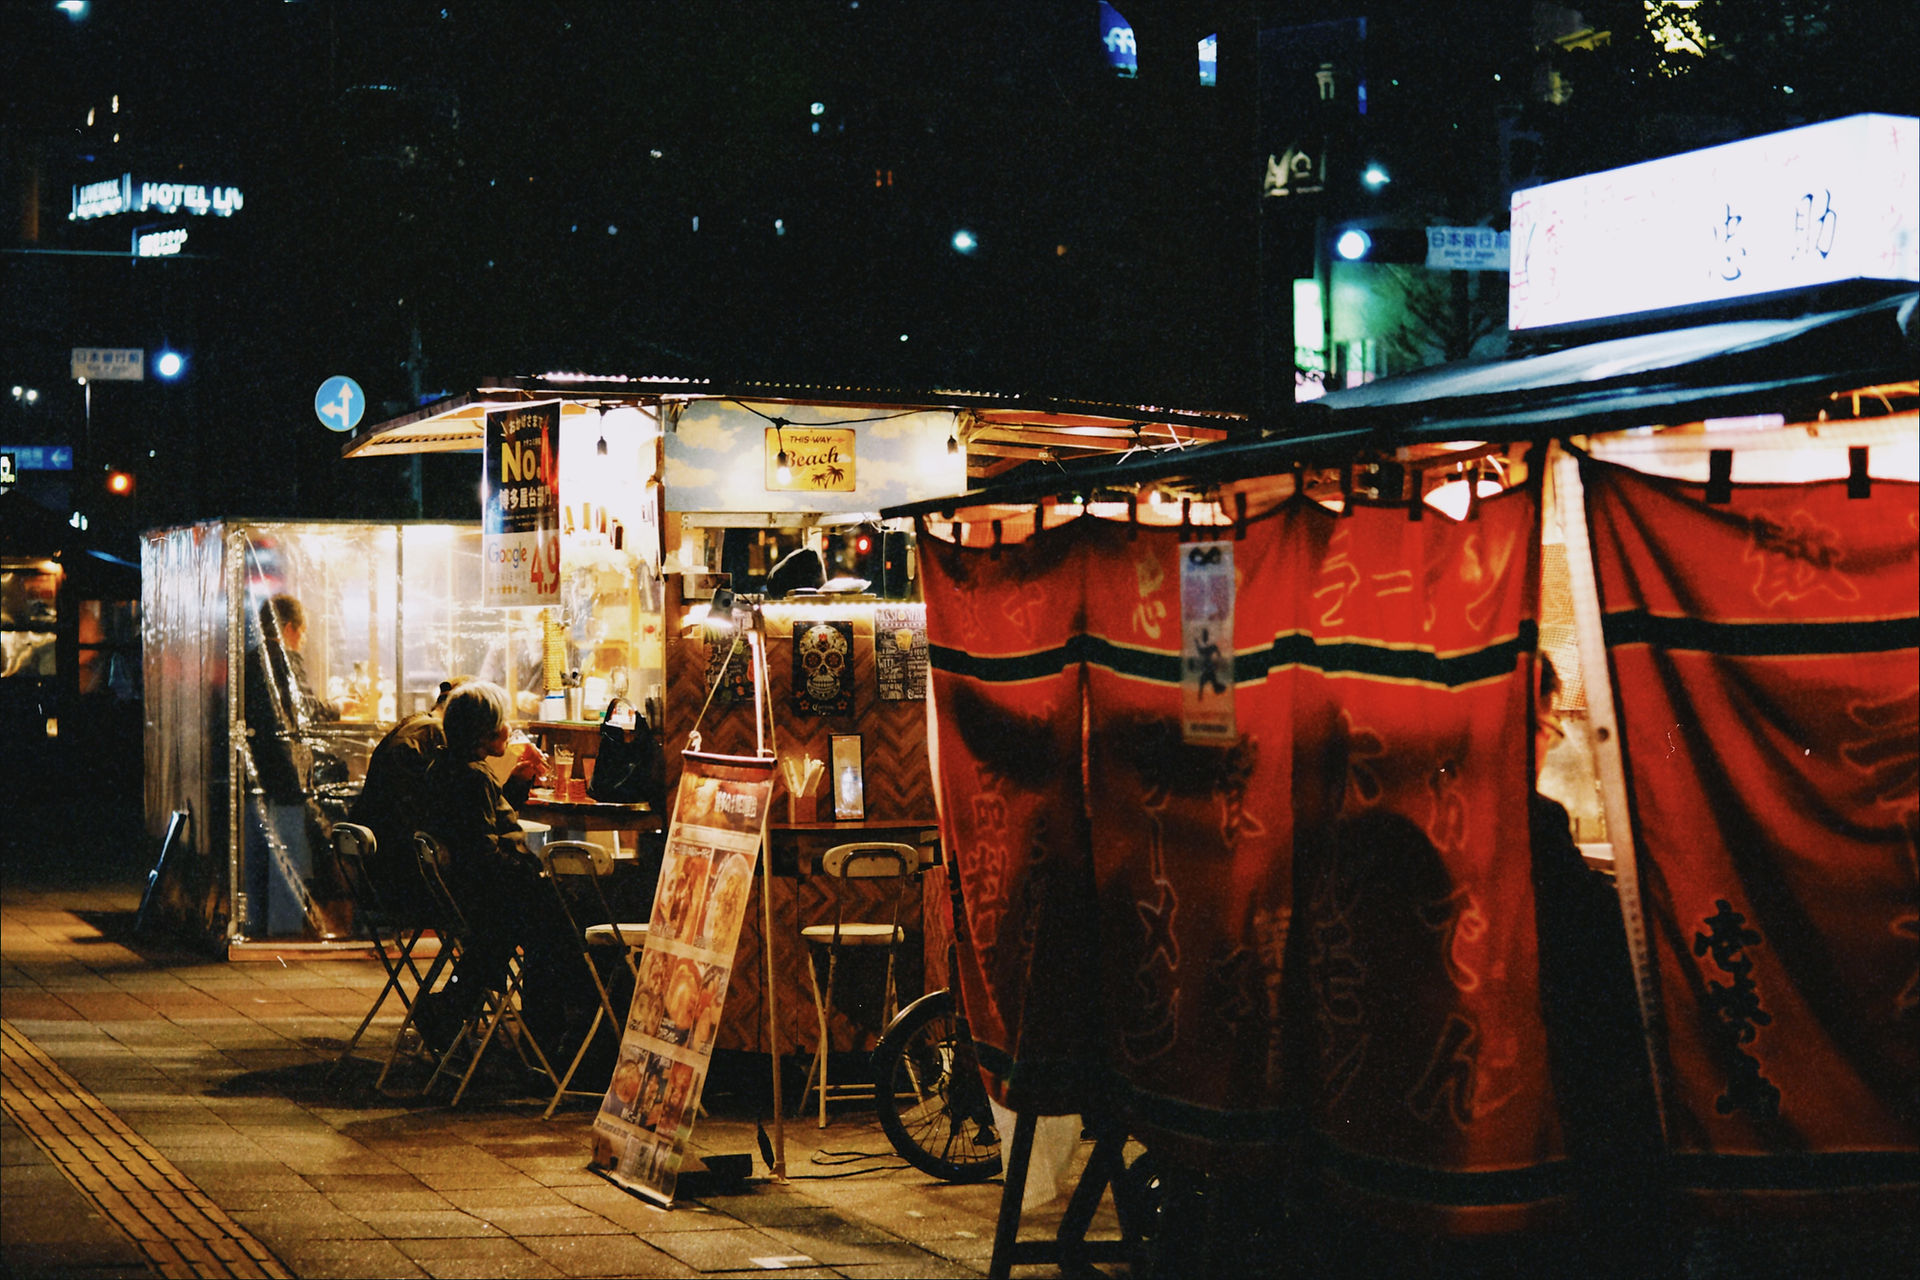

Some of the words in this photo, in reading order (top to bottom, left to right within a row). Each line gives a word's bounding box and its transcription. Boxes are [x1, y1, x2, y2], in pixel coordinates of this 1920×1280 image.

[142, 182, 211, 208] HOTEL
[790, 435, 810, 444] THIS
[812, 435, 832, 444] WAY
[785, 445, 840, 468] Beach
[487, 542, 527, 569] Google
[530, 535, 560, 595] 4.9
